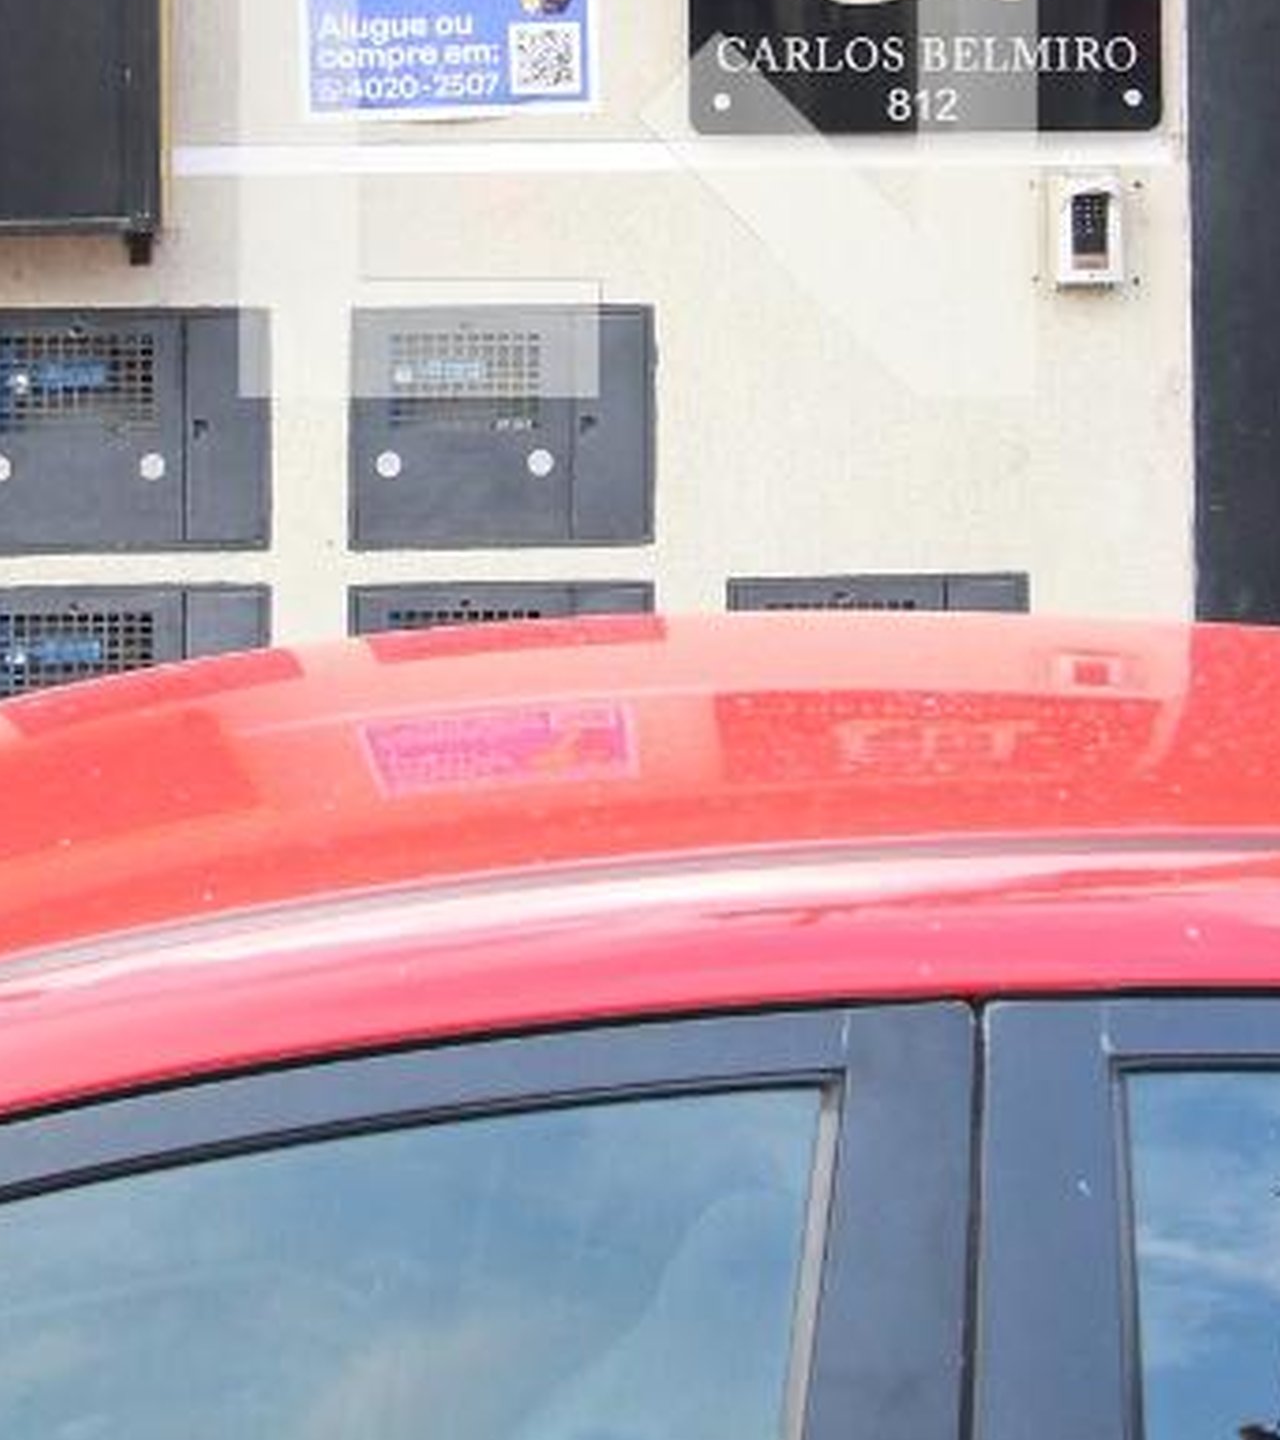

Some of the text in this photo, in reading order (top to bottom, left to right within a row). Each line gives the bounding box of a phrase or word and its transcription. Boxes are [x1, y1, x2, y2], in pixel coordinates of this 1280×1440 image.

[321, 14, 473, 44] Alugue ou
[319, 44, 500, 72] compre em:
[716, 35, 1138, 73] CARLOS BELMIRO
[887, 87, 959, 122] 812
